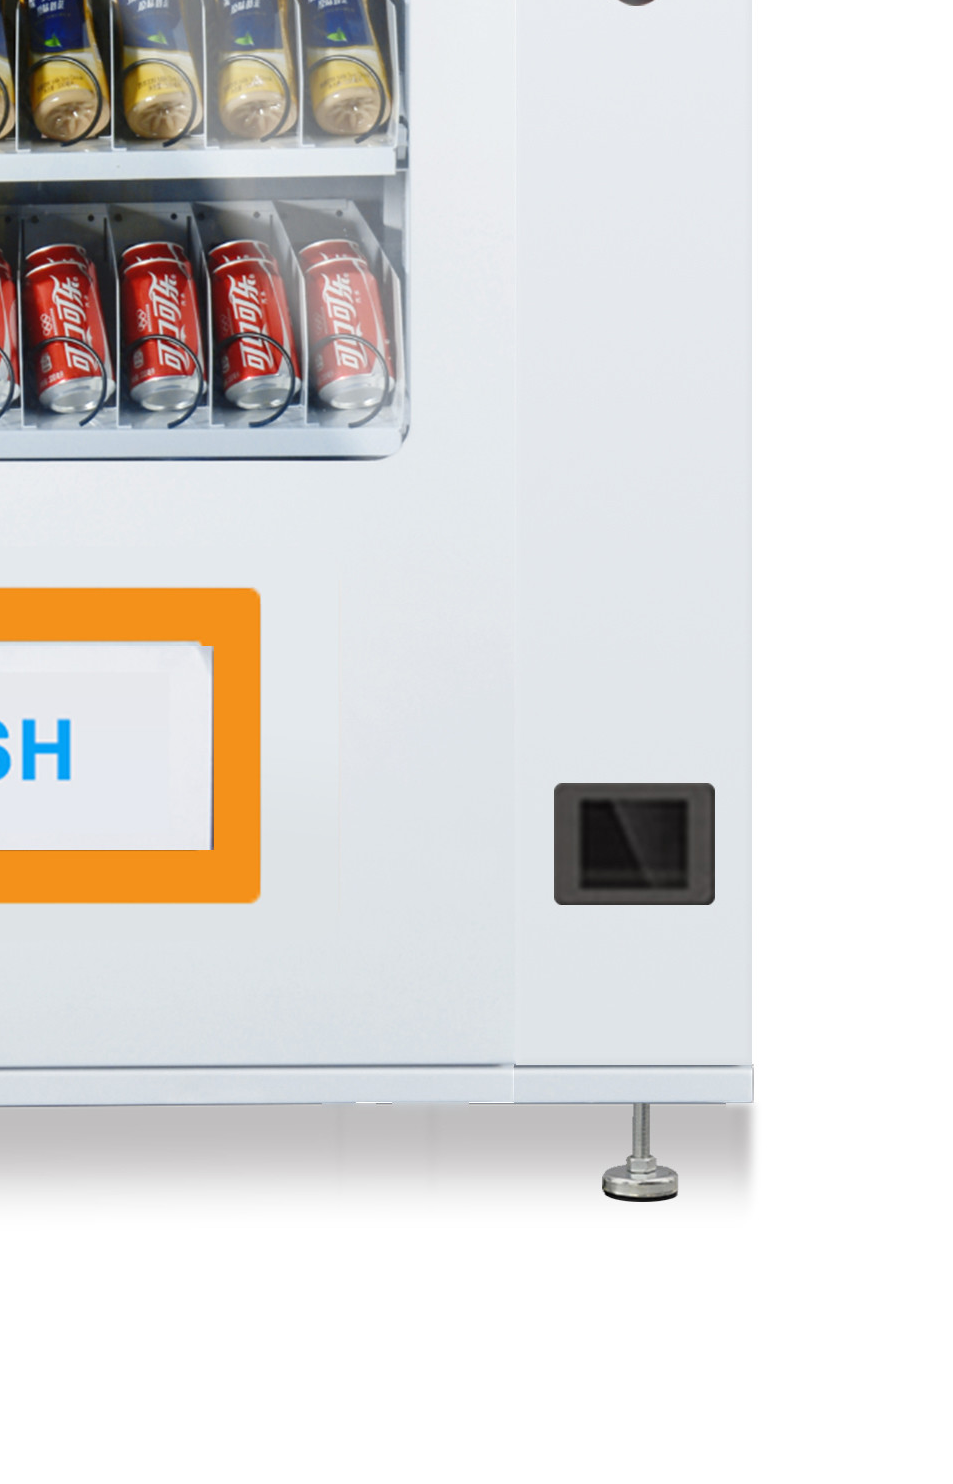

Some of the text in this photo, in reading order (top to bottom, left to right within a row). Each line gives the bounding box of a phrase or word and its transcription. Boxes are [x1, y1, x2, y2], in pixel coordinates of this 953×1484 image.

[50, 275, 97, 373] 可口可乐
[148, 271, 190, 371] 可口可乐
[228, 274, 274, 371] 可口可乐
[321, 273, 367, 369] 可口可乐
